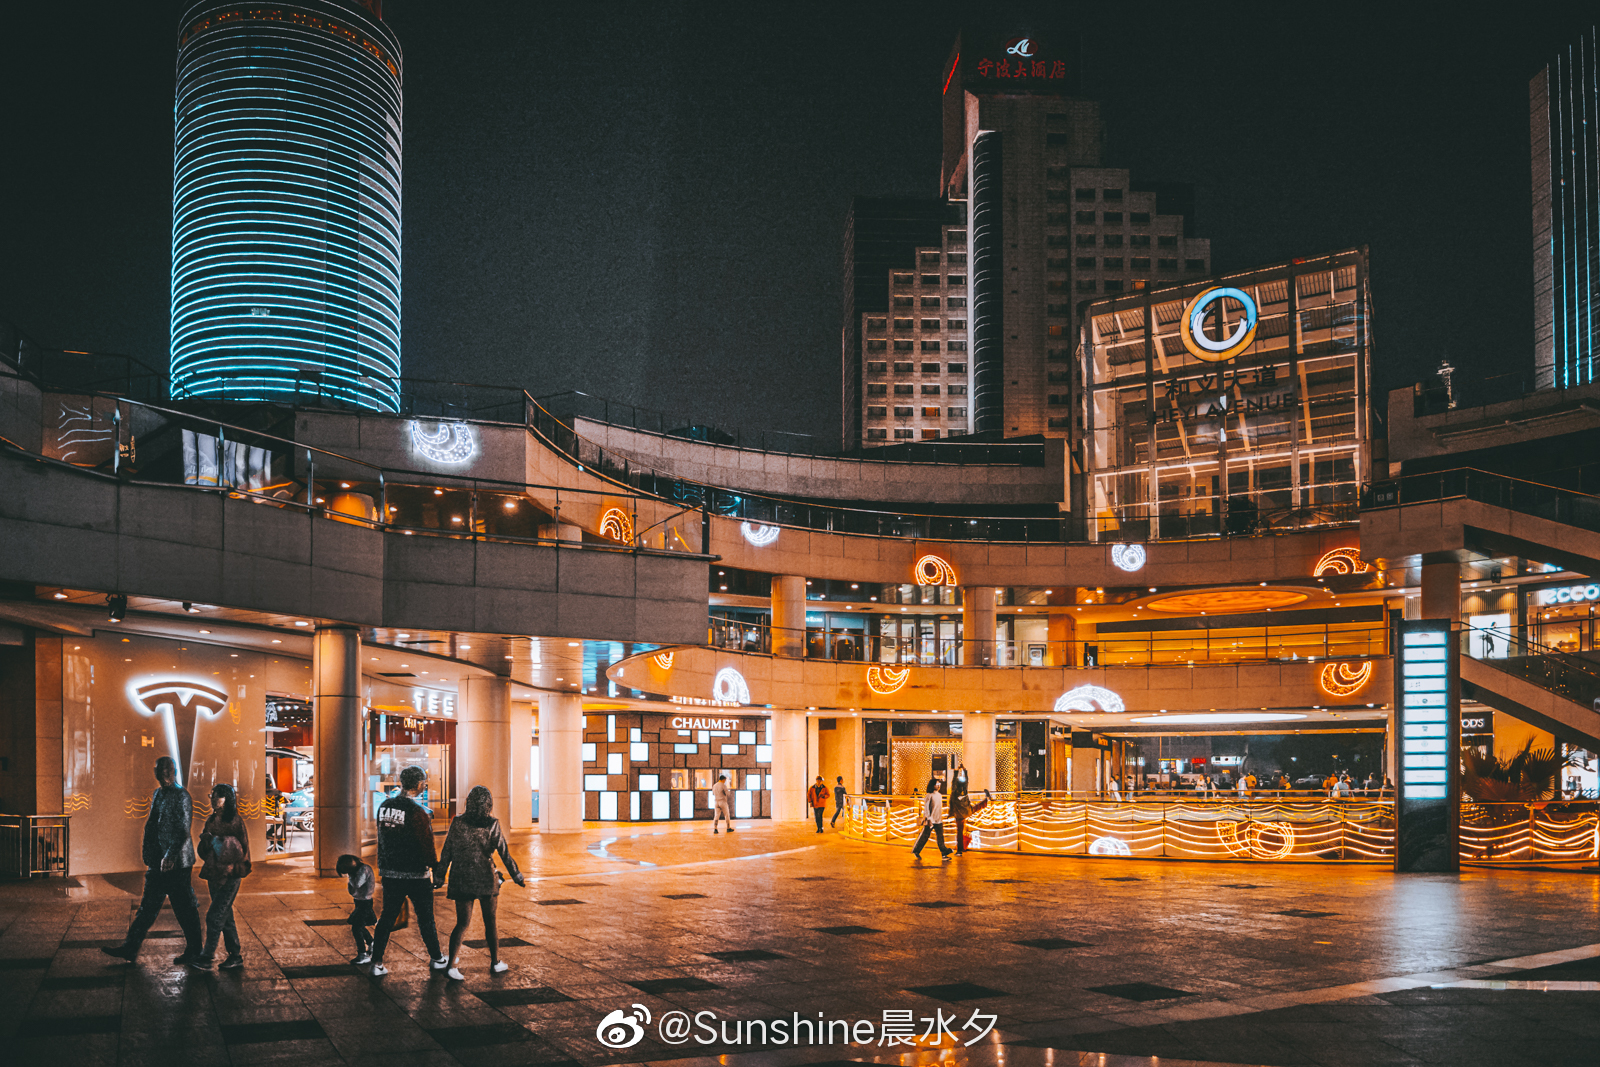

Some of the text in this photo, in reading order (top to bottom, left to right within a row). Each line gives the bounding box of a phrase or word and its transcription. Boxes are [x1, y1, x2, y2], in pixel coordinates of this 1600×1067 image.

[978, 58, 1066, 79] 宁波大酒店
[1165, 365, 1279, 401] 和义大道
[1152, 392, 1293, 424] HEYI AVENUE
[1545, 585, 1600, 604] ecco
[672, 717, 739, 730] CHAUMET
[1461, 718, 1484, 729] OD'S
